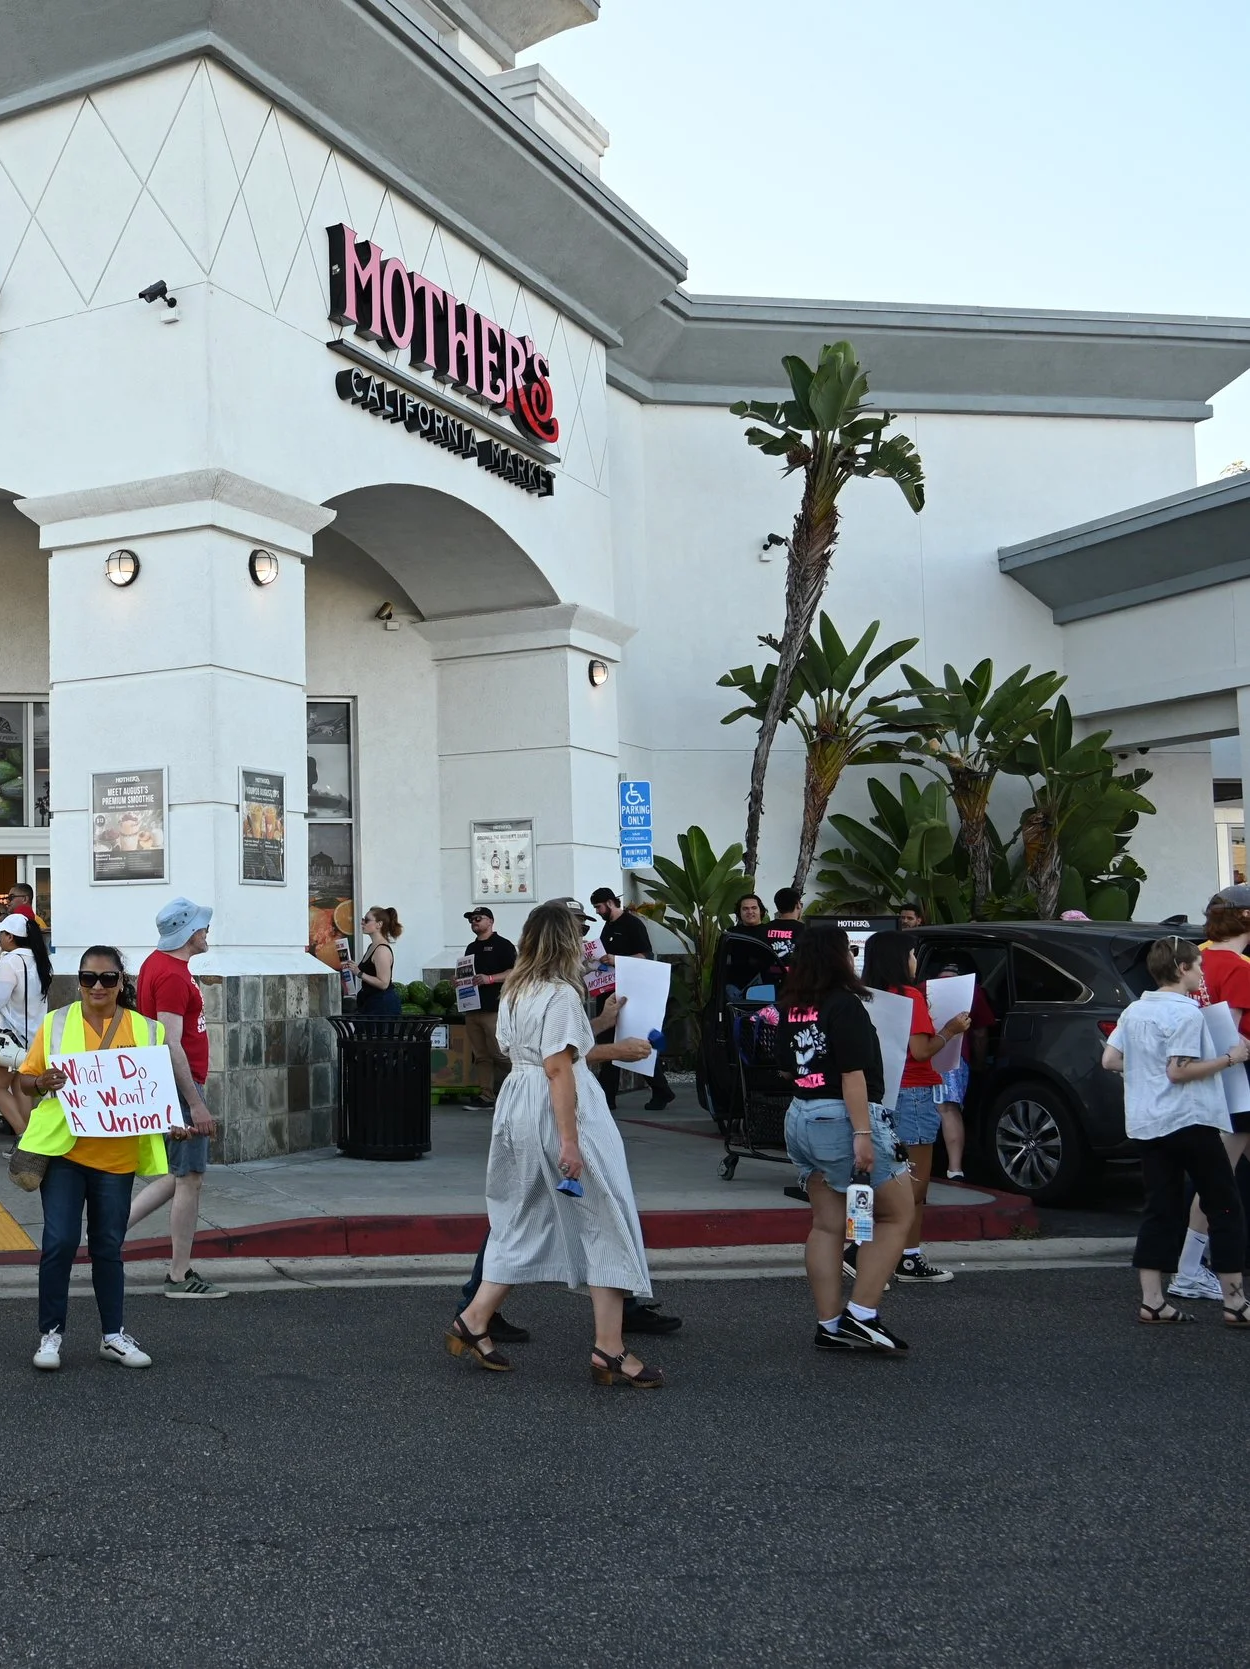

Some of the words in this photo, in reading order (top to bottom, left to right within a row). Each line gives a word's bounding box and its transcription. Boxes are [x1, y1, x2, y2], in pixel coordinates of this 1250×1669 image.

[325, 222, 560, 446] MOTHER'S
[335, 366, 479, 459] CALIFORNIA
[478, 438, 557, 498] MARKET
[107, 787, 122, 796] MEET
[123, 785, 149, 796] AUGUST'S
[102, 796, 127, 806] PREMIUM
[127, 794, 154, 805] SMOOTHIE
[621, 805, 650, 815] PARKING
[627, 815, 645, 826] ONLY
[767, 929, 793, 939] LETTUCE
[583, 940, 598, 952] ARE
[587, 972, 616, 989] MOTHER'
[51, 1054, 106, 1086] What
[117, 1054, 148, 1080] Do
[62, 1088, 92, 1110] We
[97, 1080, 158, 1108] Want?
[70, 1111, 87, 1133] A
[97, 1104, 172, 1134] Union!
